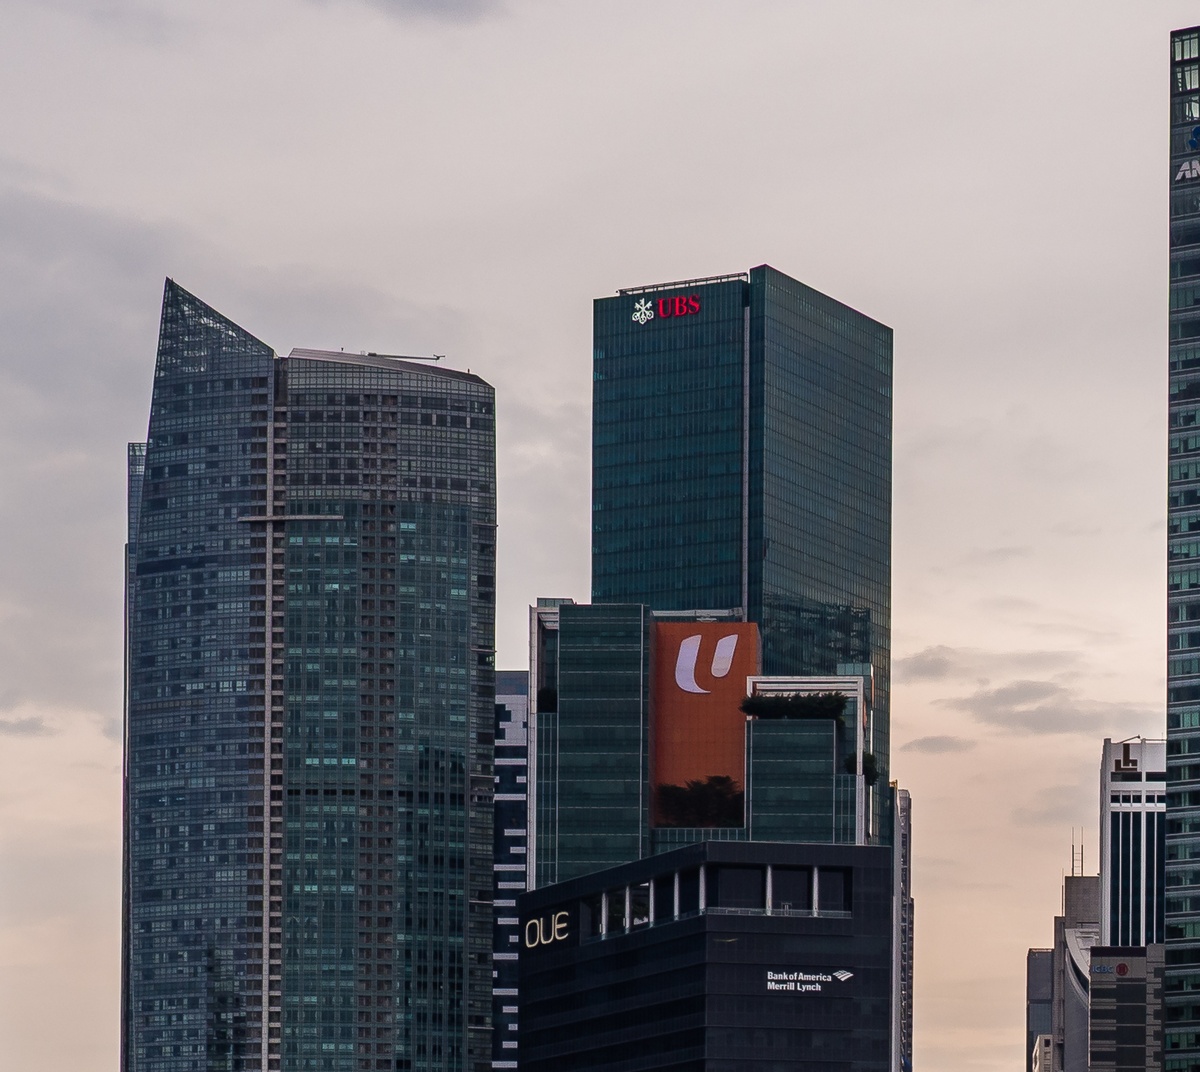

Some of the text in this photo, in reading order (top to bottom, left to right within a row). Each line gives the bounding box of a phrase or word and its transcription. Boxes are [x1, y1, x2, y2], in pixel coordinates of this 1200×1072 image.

[657, 294, 700, 319] UBS
[525, 911, 569, 948] OUE
[767, 971, 832, 981] Bank of America
[767, 981, 821, 992] Merrill Lynch
